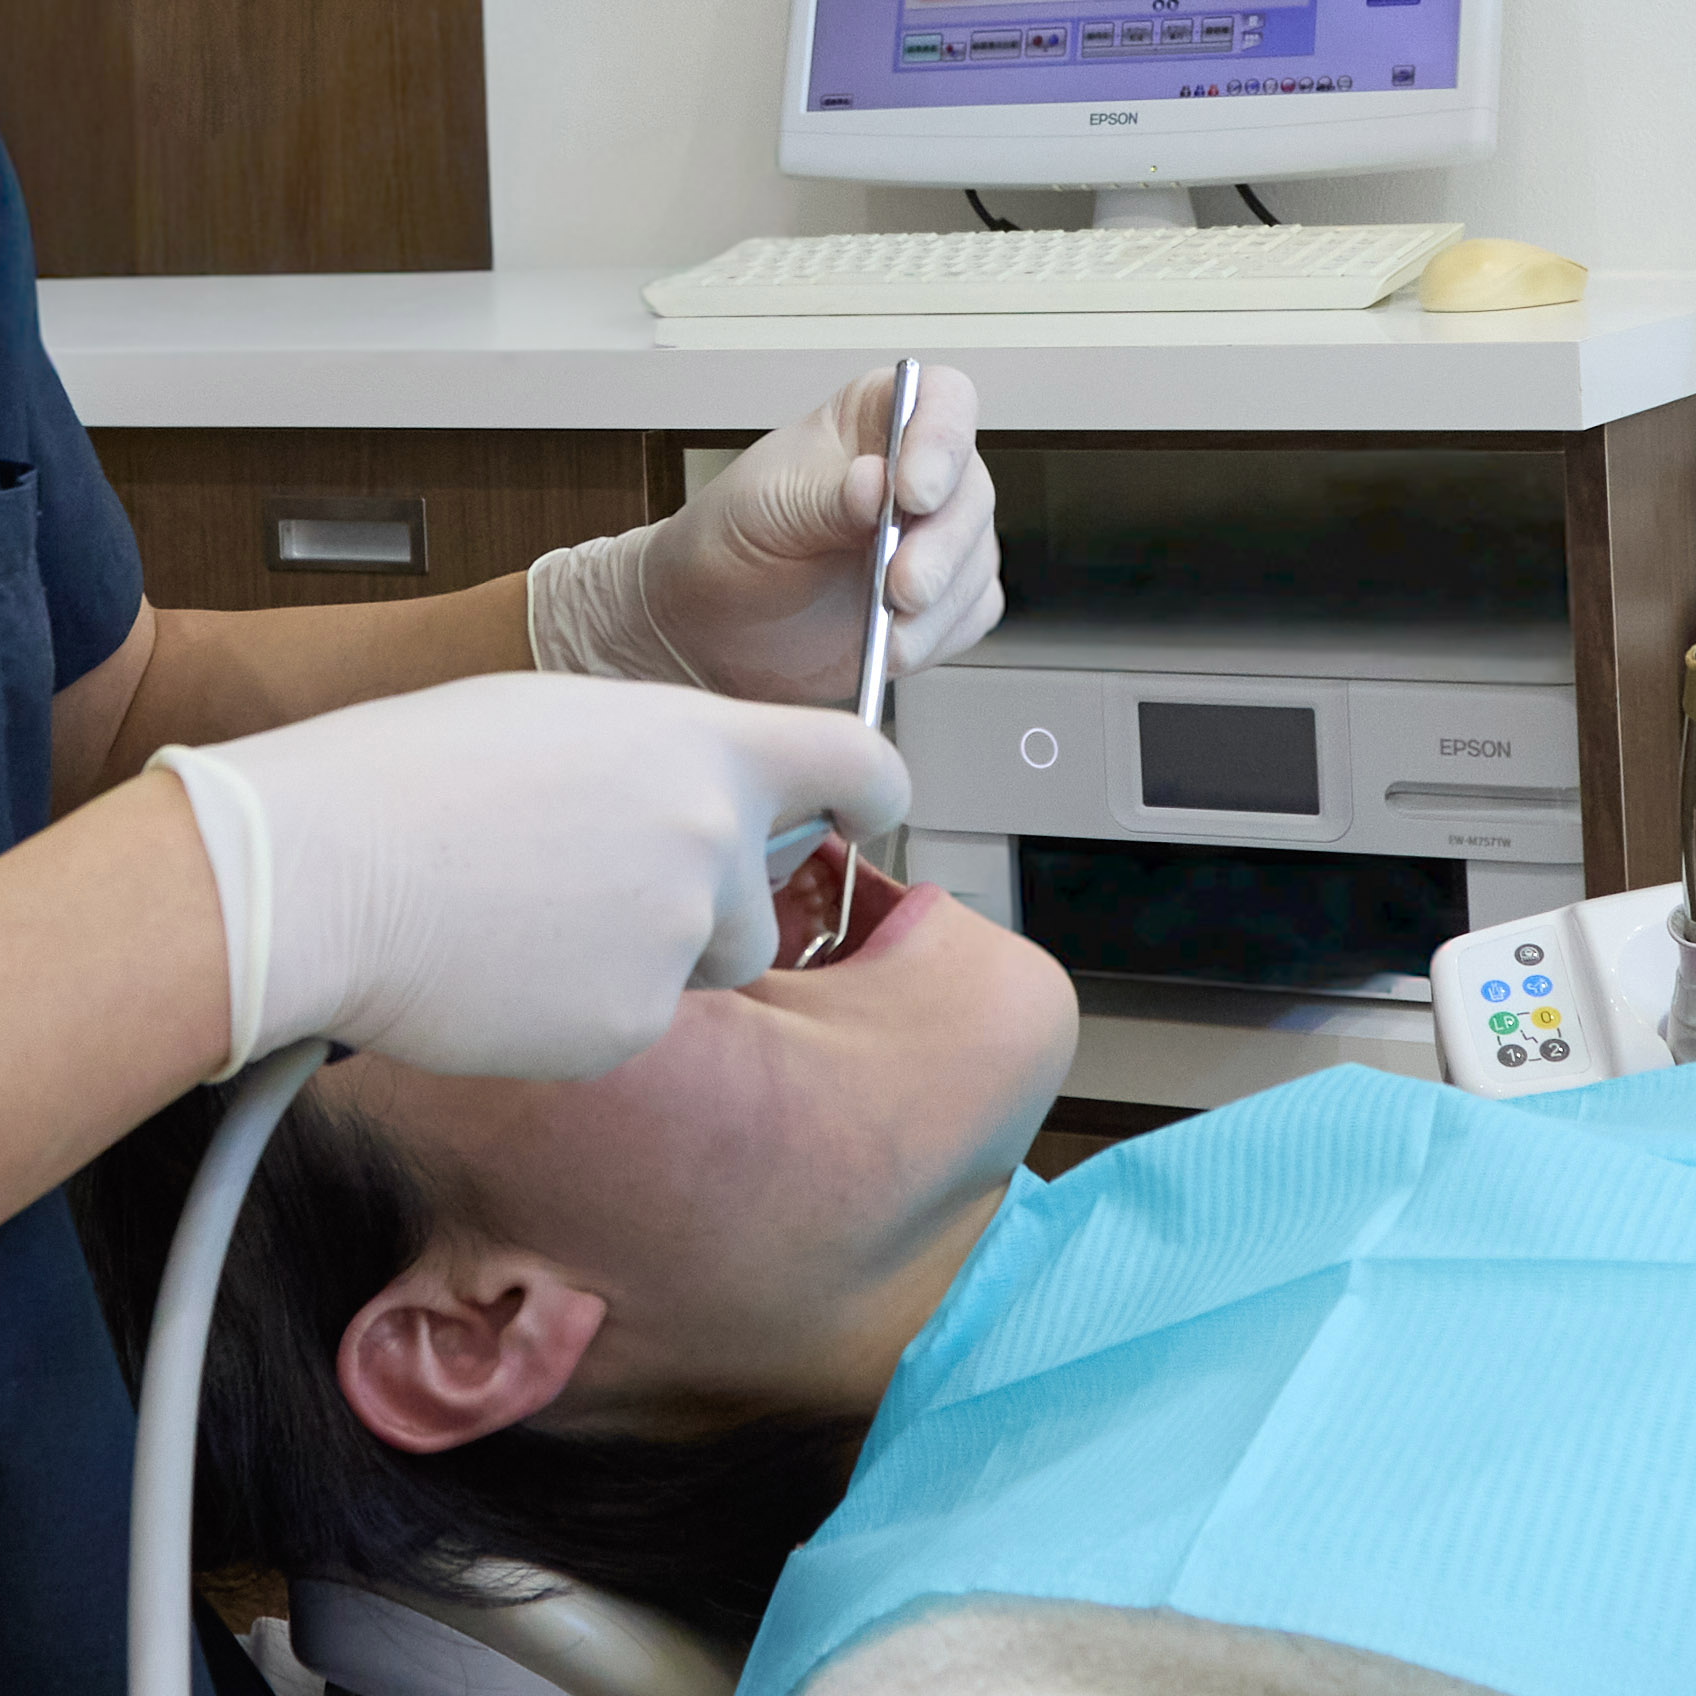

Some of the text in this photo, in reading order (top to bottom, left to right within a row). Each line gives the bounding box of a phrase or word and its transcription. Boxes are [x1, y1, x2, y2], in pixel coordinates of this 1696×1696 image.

[1089, 112, 1138, 125] EPSON
[1440, 738, 1511, 758] EPSON
[1506, 1048, 1517, 1063] 1
[1548, 1042, 1562, 1057] 2
